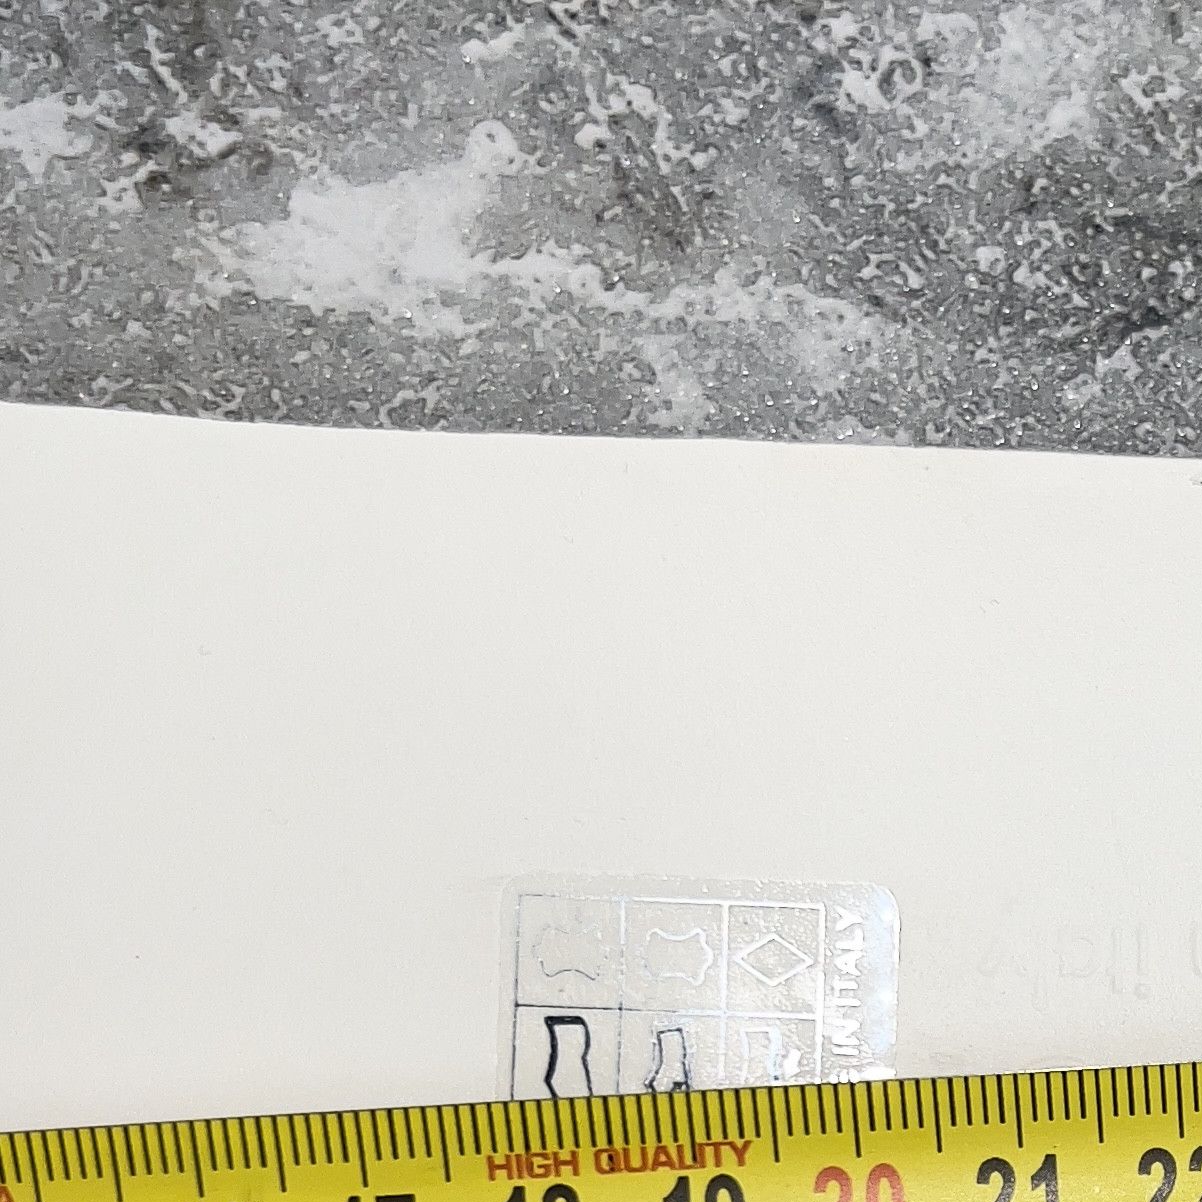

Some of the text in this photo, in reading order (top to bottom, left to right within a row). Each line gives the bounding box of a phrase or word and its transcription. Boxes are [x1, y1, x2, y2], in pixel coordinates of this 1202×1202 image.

[832, 905, 864, 1008] ITALY
[487, 1140, 754, 1182] HIGH QUALITY
